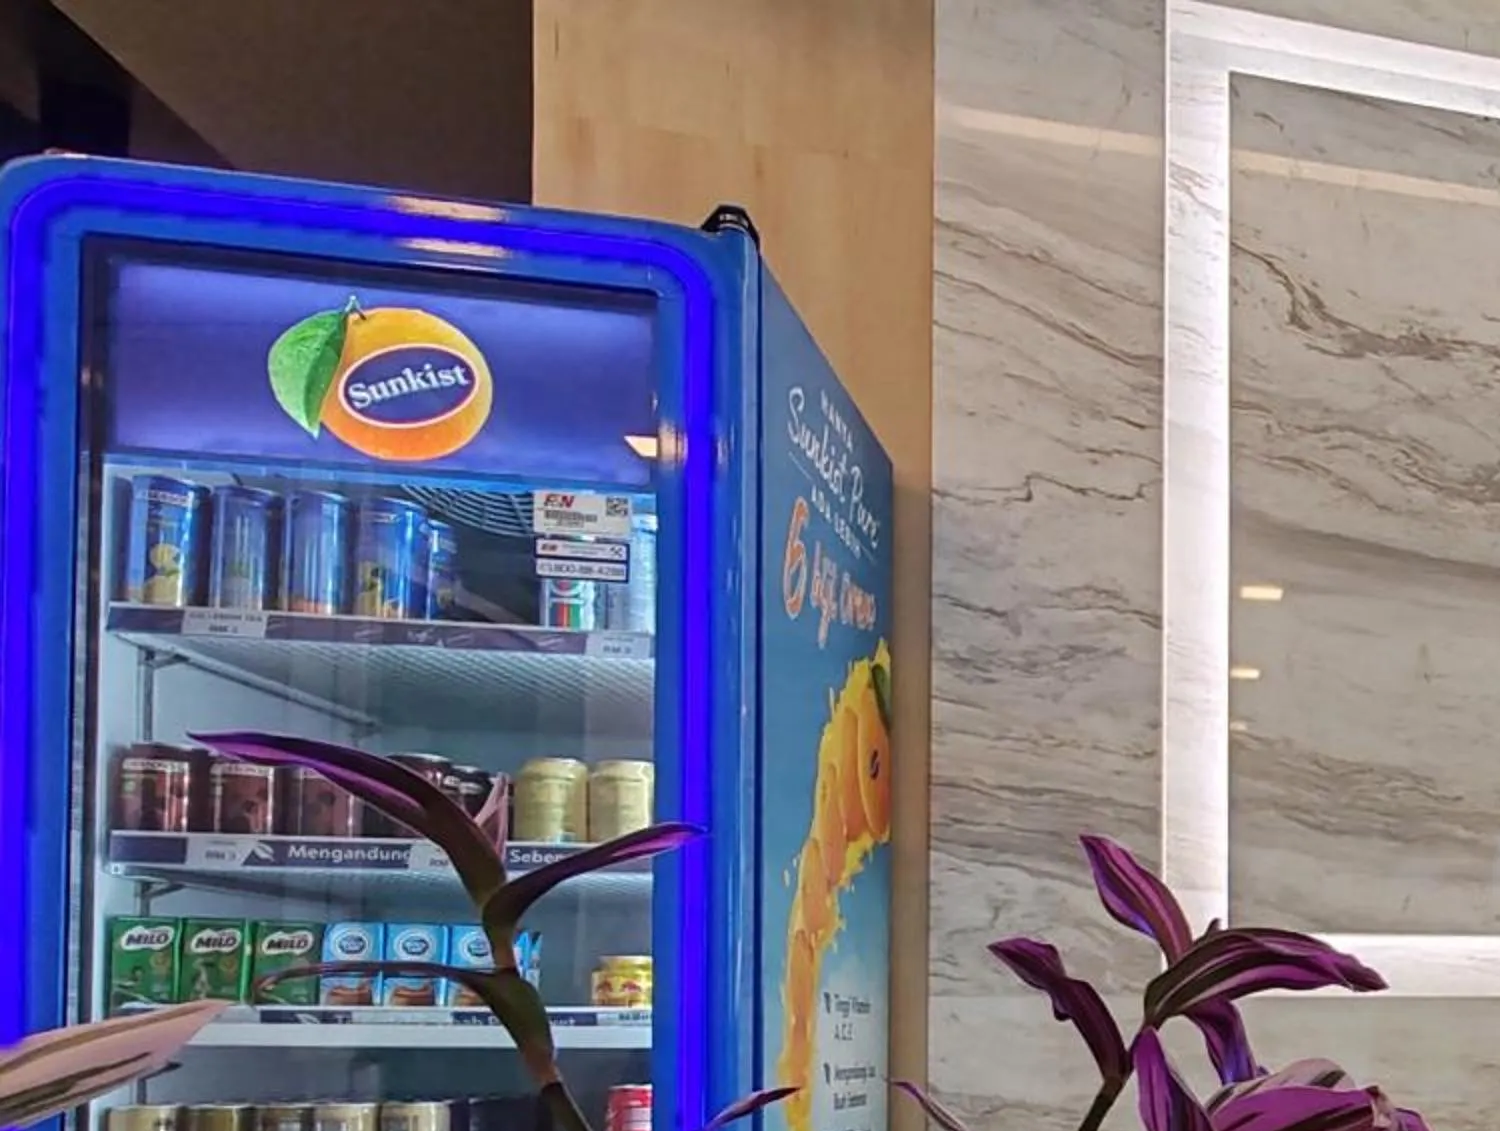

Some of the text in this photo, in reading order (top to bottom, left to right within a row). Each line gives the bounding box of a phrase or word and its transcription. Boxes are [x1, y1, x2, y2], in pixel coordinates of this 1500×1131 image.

[348, 362, 472, 411] Sunkist
[783, 496, 809, 620] 6
[126, 932, 169, 946] MILO
[194, 933, 238, 949] MILO
[265, 936, 310, 951] MILO
